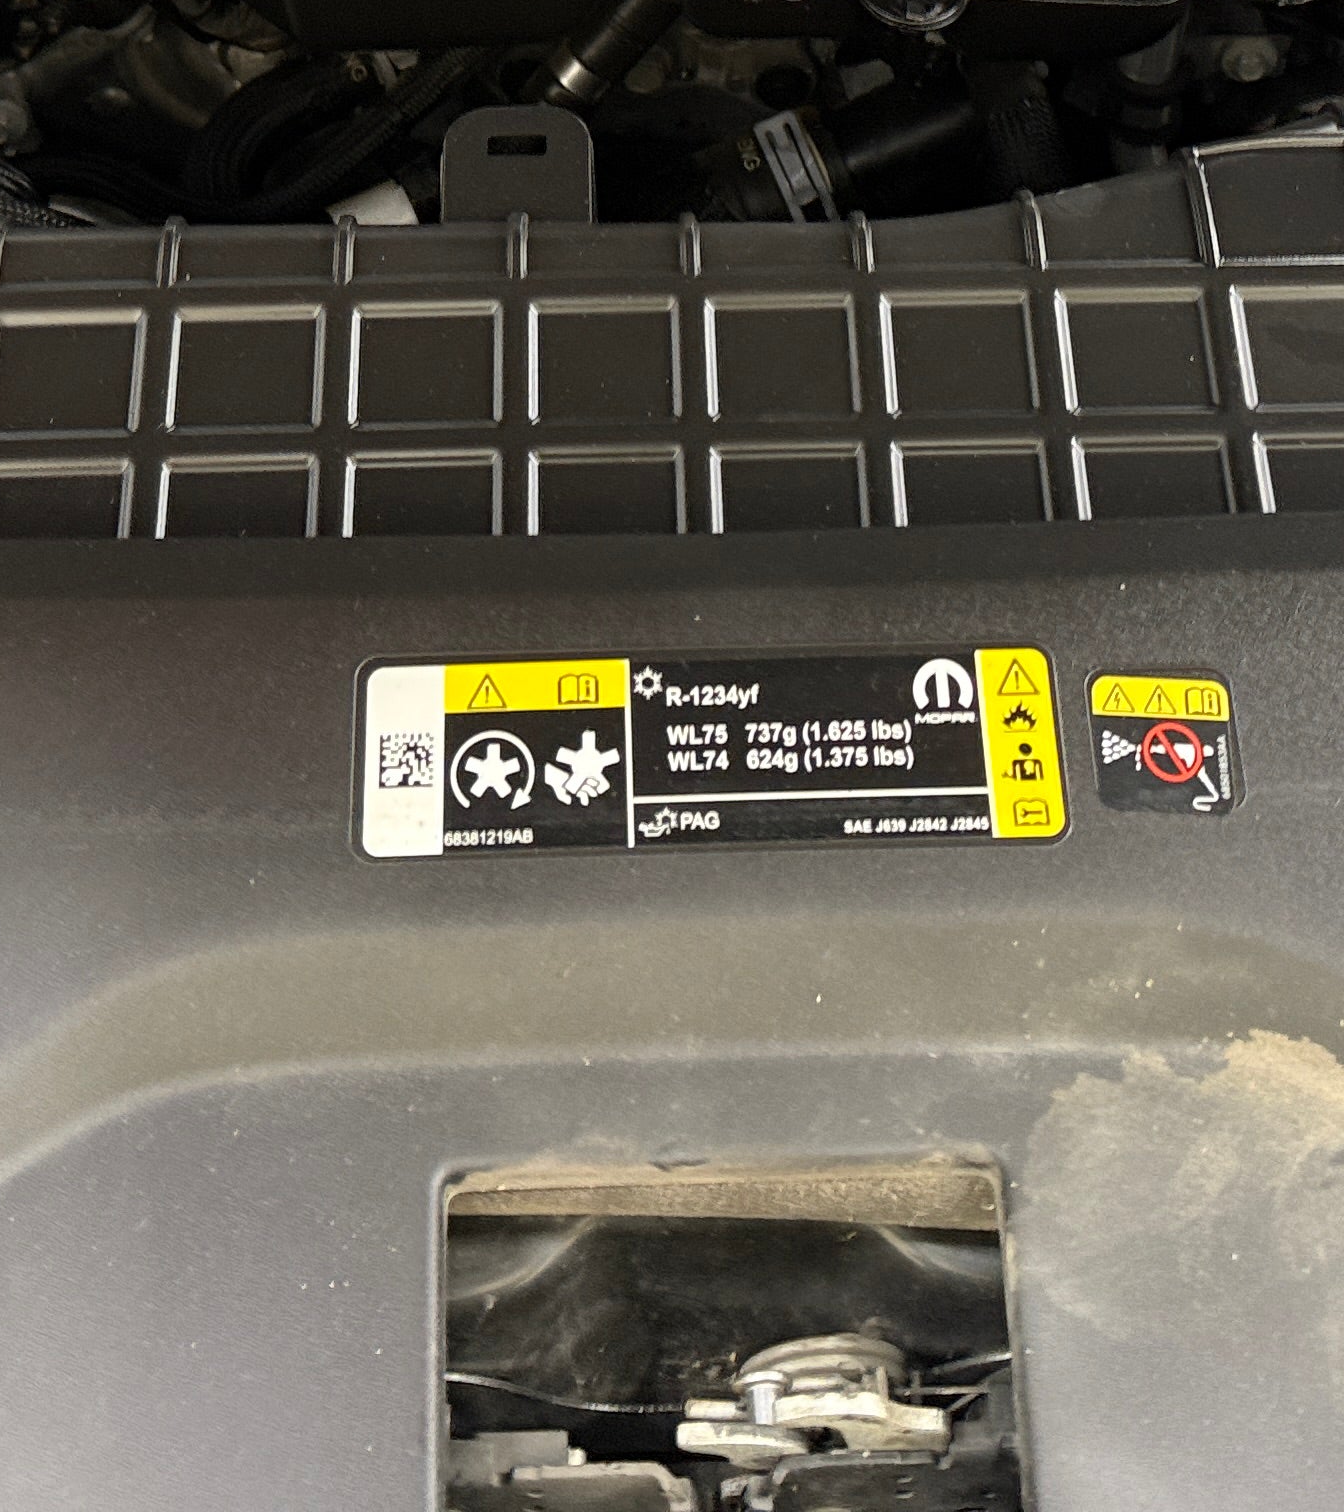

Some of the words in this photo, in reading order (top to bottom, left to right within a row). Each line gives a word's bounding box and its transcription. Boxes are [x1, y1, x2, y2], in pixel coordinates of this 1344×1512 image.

[666, 682, 759, 709] R-1234yf
[914, 711, 976, 724] MOPAR
[666, 723, 728, 745] WL75
[745, 721, 797, 747] 737g
[802, 719, 866, 746] (1.625
[871, 718, 911, 744] lbs)
[667, 749, 729, 772] WL74
[746, 748, 798, 773] 624g
[804, 745, 868, 772] (1.375
[873, 744, 914, 770] lbs)
[680, 810, 720, 830] PAG
[843, 818, 873, 834] SAE
[875, 818, 906, 833] J639
